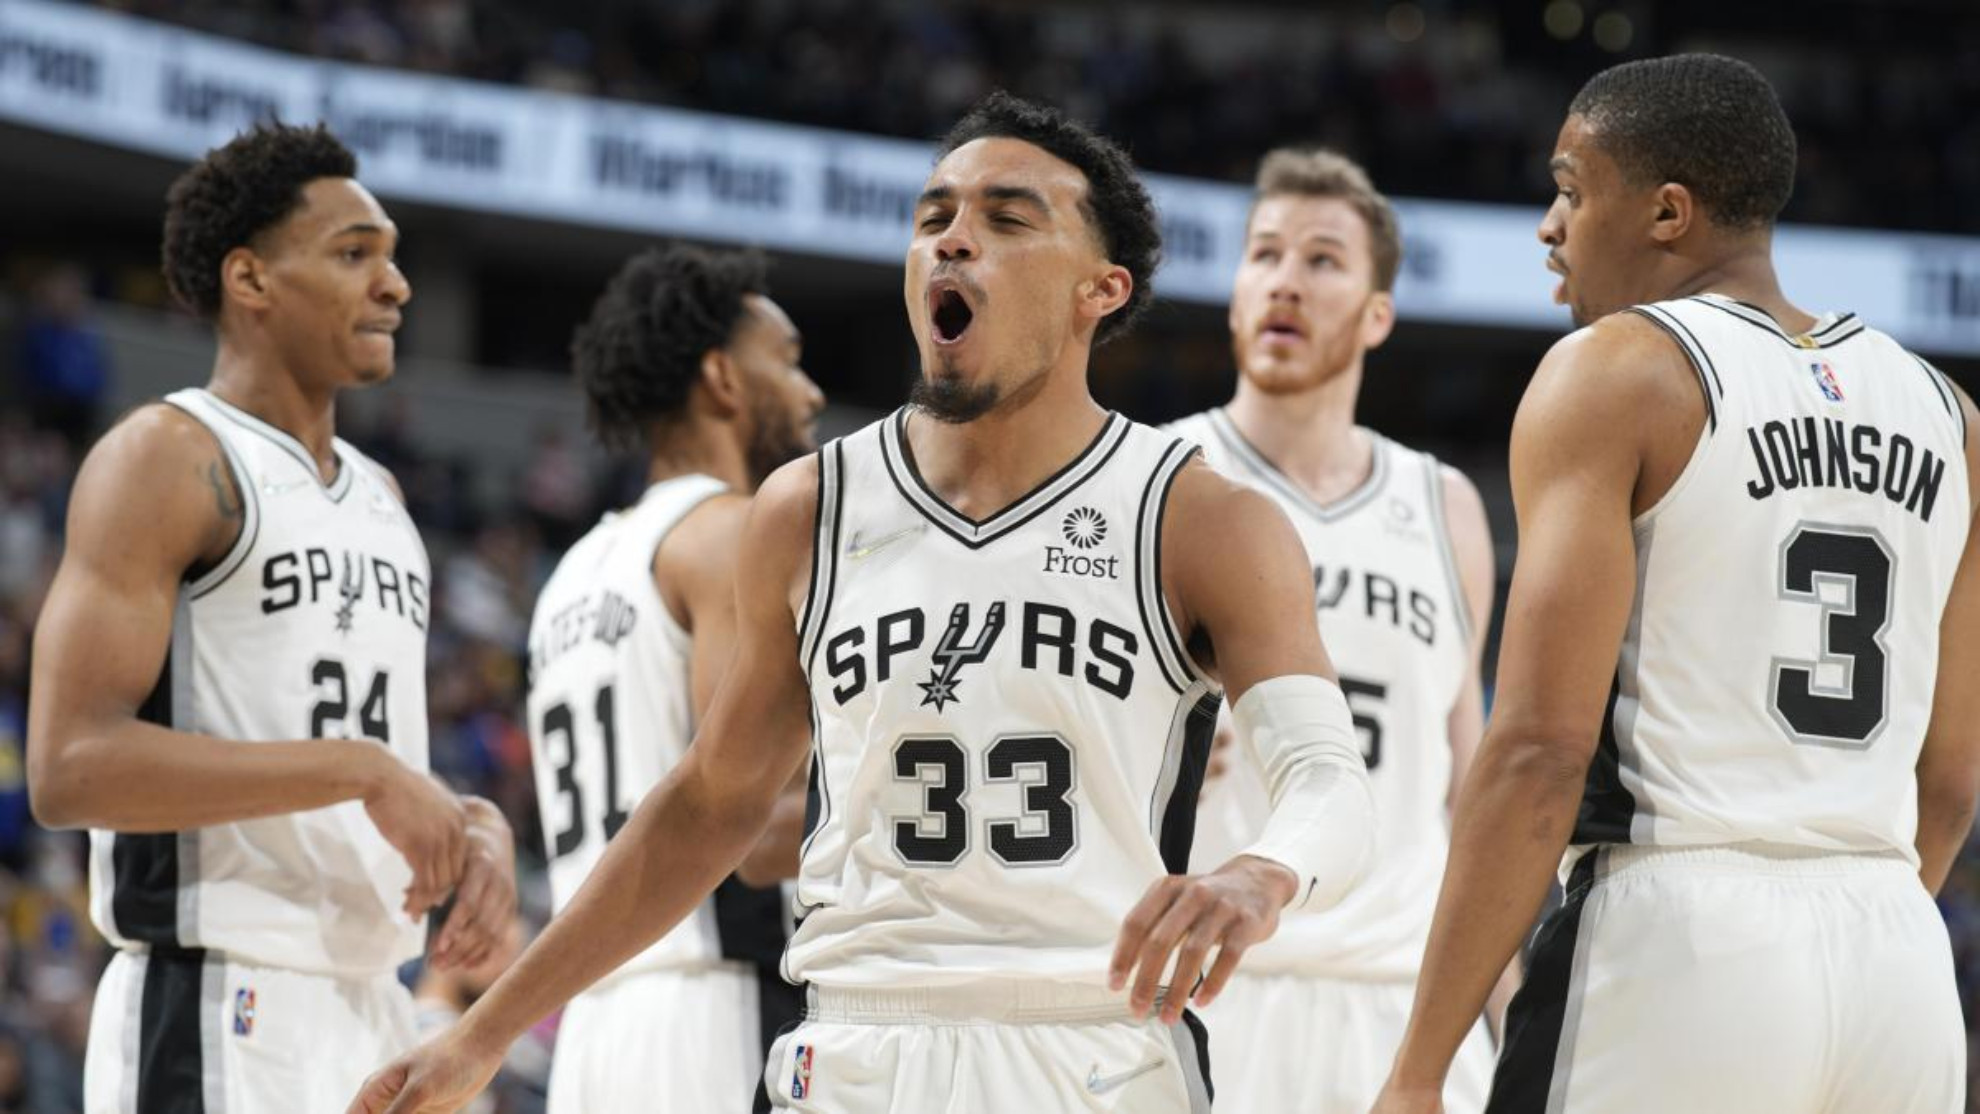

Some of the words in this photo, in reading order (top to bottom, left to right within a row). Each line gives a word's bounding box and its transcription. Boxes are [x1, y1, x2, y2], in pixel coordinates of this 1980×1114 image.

[1746, 416, 1946, 524] JOHNSON
[261, 548, 427, 636] SPURS
[1042, 545, 1119, 580] Frost
[1312, 563, 1436, 647] URS
[825, 600, 1139, 715] SPURS
[1764, 518, 1899, 752] 3
[311, 657, 390, 744] 24
[1337, 675, 1387, 770] 5
[542, 684, 629, 858] 31
[890, 731, 1080, 869] 33
